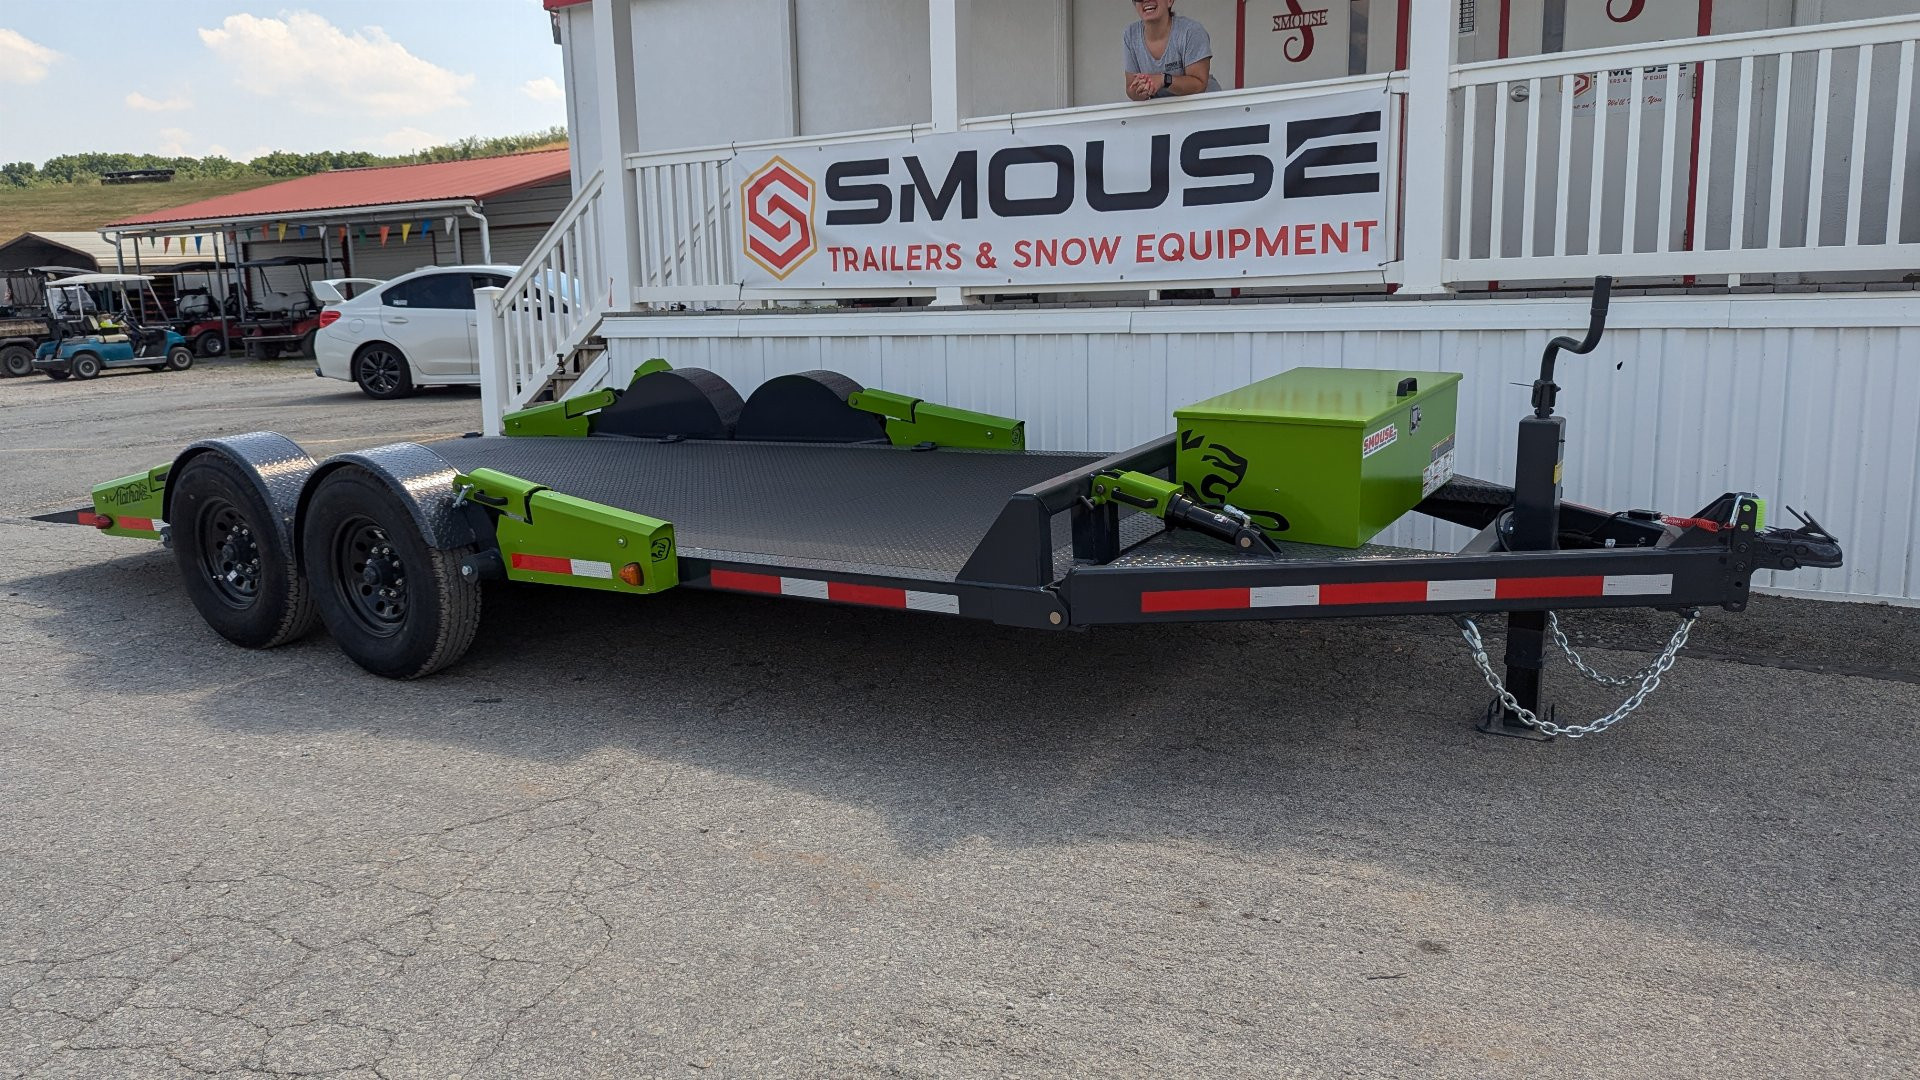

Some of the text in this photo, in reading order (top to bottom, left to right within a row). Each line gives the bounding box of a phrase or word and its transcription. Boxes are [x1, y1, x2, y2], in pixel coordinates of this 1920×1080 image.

[1272, 9, 1329, 31] SMOUSE
[824, 110, 1381, 226] SMOUSE
[827, 220, 1379, 273] TRAILERS & SNOW EQUIPMENT
